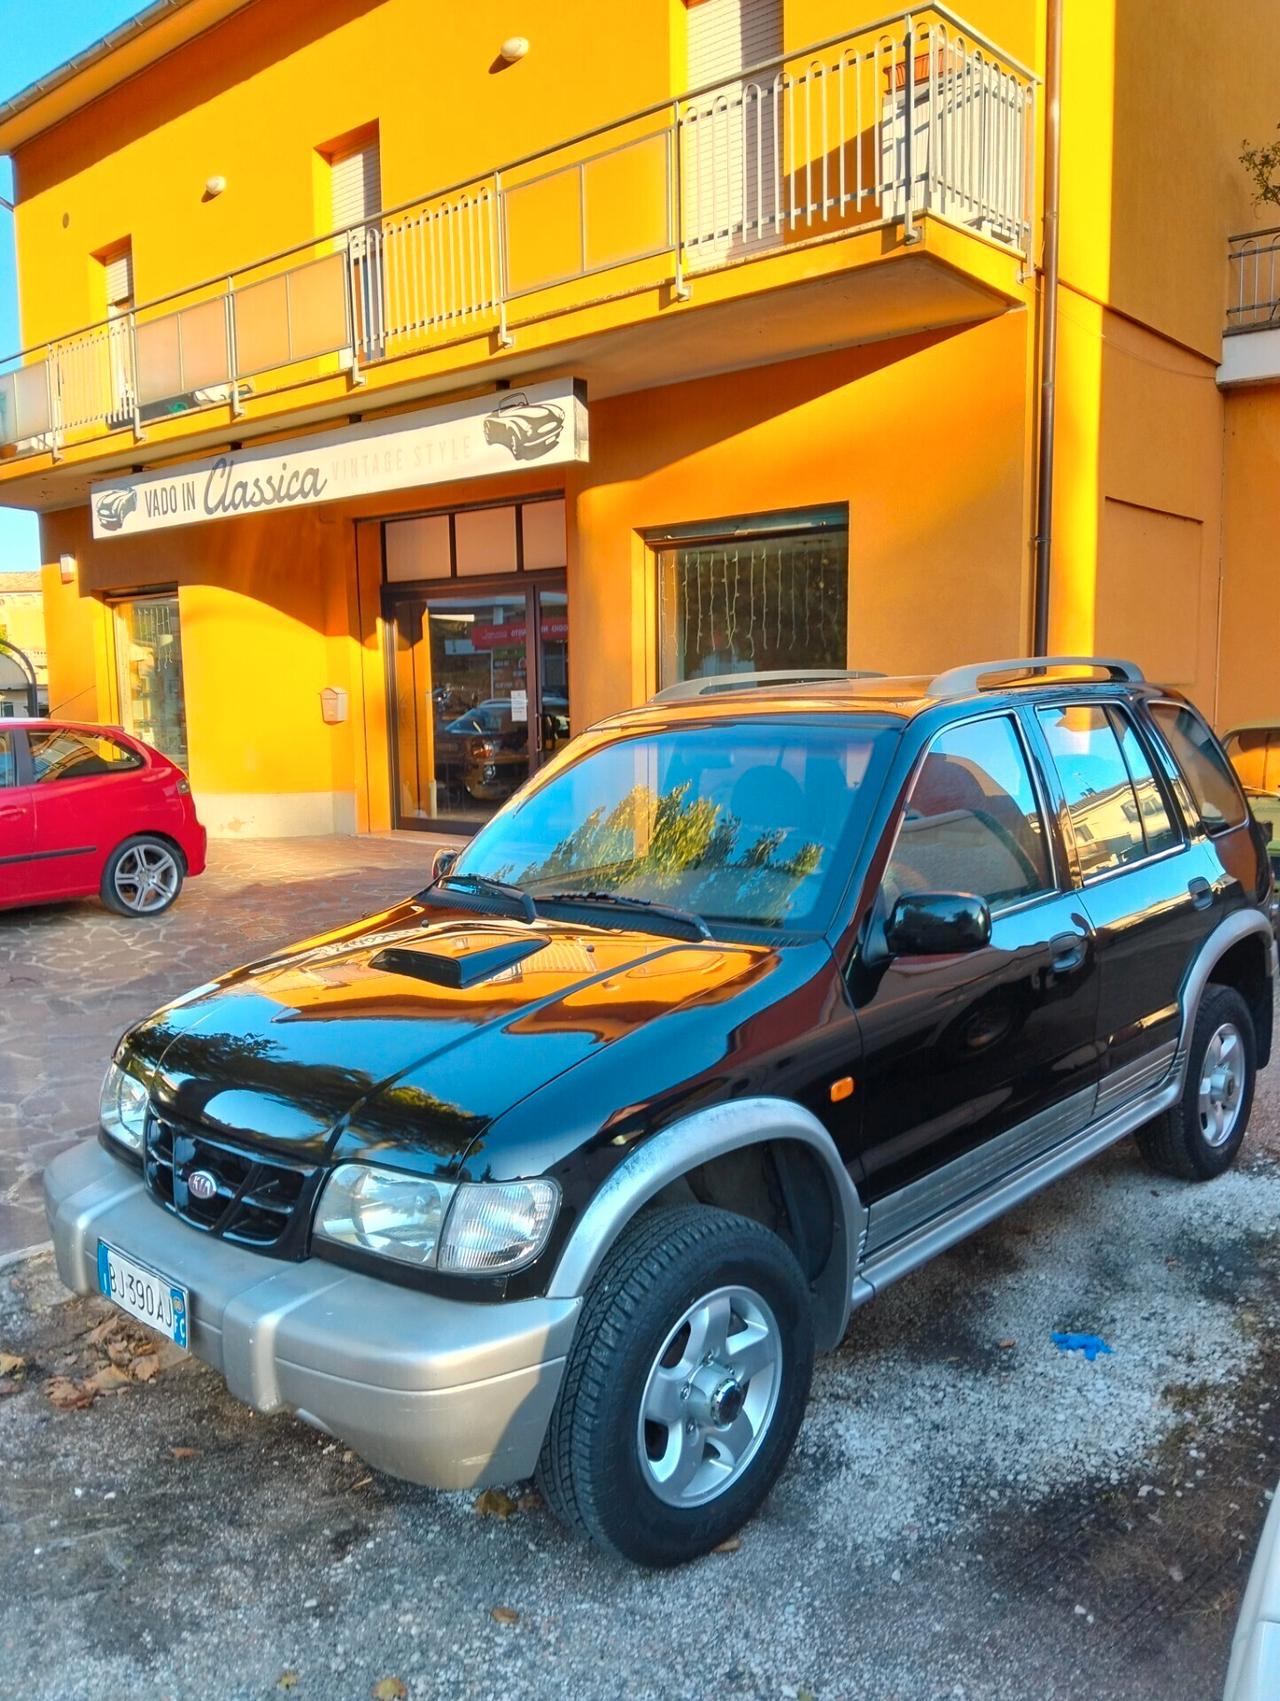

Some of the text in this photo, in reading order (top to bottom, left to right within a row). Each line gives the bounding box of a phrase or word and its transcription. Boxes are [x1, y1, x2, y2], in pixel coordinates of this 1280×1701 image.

[144, 434, 471, 519] VADO IN Classica VINTAGE STYLE
